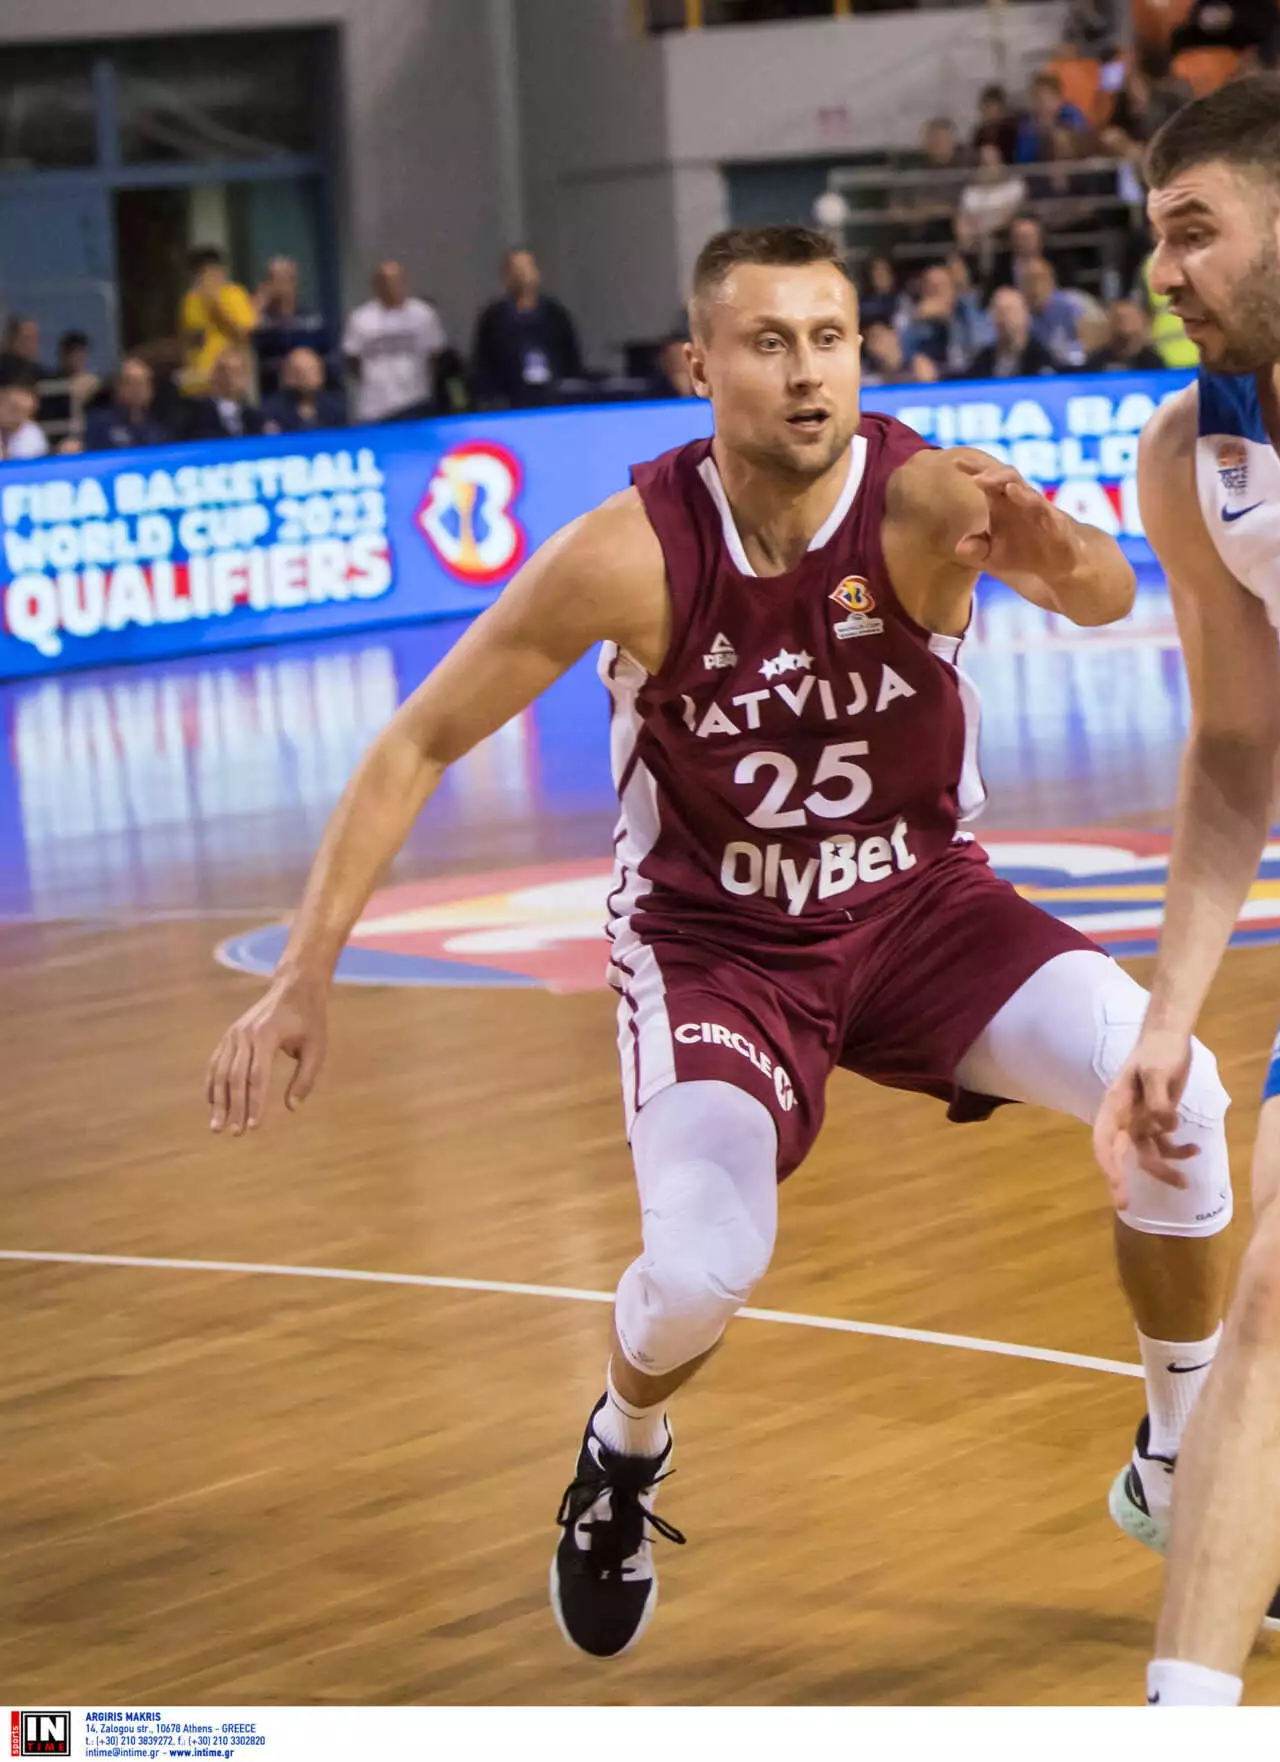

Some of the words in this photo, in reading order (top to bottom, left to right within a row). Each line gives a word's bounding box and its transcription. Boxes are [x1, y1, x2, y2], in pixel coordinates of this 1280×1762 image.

[2, 478, 109, 527] FIBA
[114, 448, 384, 515] BASKETBALL
[4, 514, 173, 575] WORLD
[178, 502, 270, 553] CUP
[275, 490, 385, 543] 2023
[5, 532, 392, 657] QUALIFIERS
[734, 741, 873, 828] 25
[720, 816, 917, 916] OlyBet
[674, 1022, 772, 1079] CIRCLE
